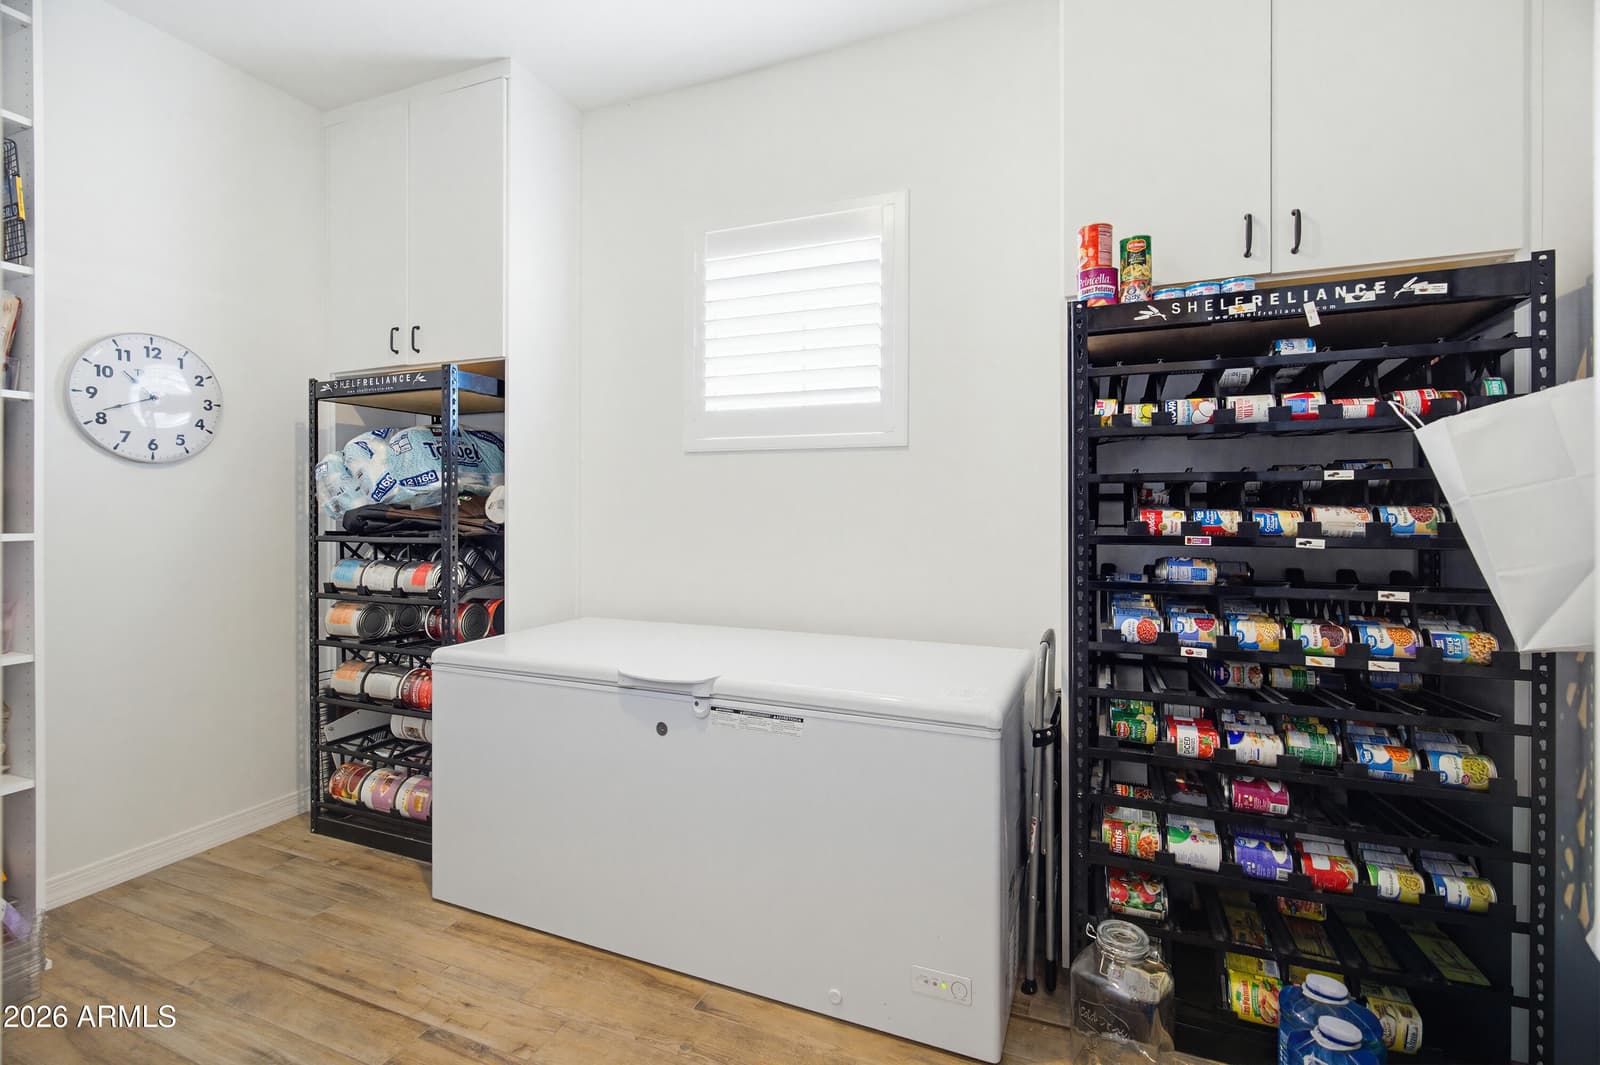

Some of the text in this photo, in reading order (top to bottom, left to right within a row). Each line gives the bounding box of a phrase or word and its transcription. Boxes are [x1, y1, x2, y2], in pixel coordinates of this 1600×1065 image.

[1171, 280, 1387, 314] SHELFRELIANCE
[1207, 304, 1336, 320] www.shelfrelianccom
[115, 348, 131, 361] 11
[144, 346, 162, 359] 12
[177, 357, 184, 369] 1
[94, 364, 114, 378] 10
[194, 375, 205, 387] 2
[333, 374, 411, 389] SHELFRELIANCE
[85, 386, 98, 399] 9
[203, 400, 213, 411] 3
[95, 412, 107, 425] 8
[194, 419, 205, 431] 4
[119, 430, 131, 442] 7
[175, 434, 186, 446] 5
[147, 439, 158, 451] 6
